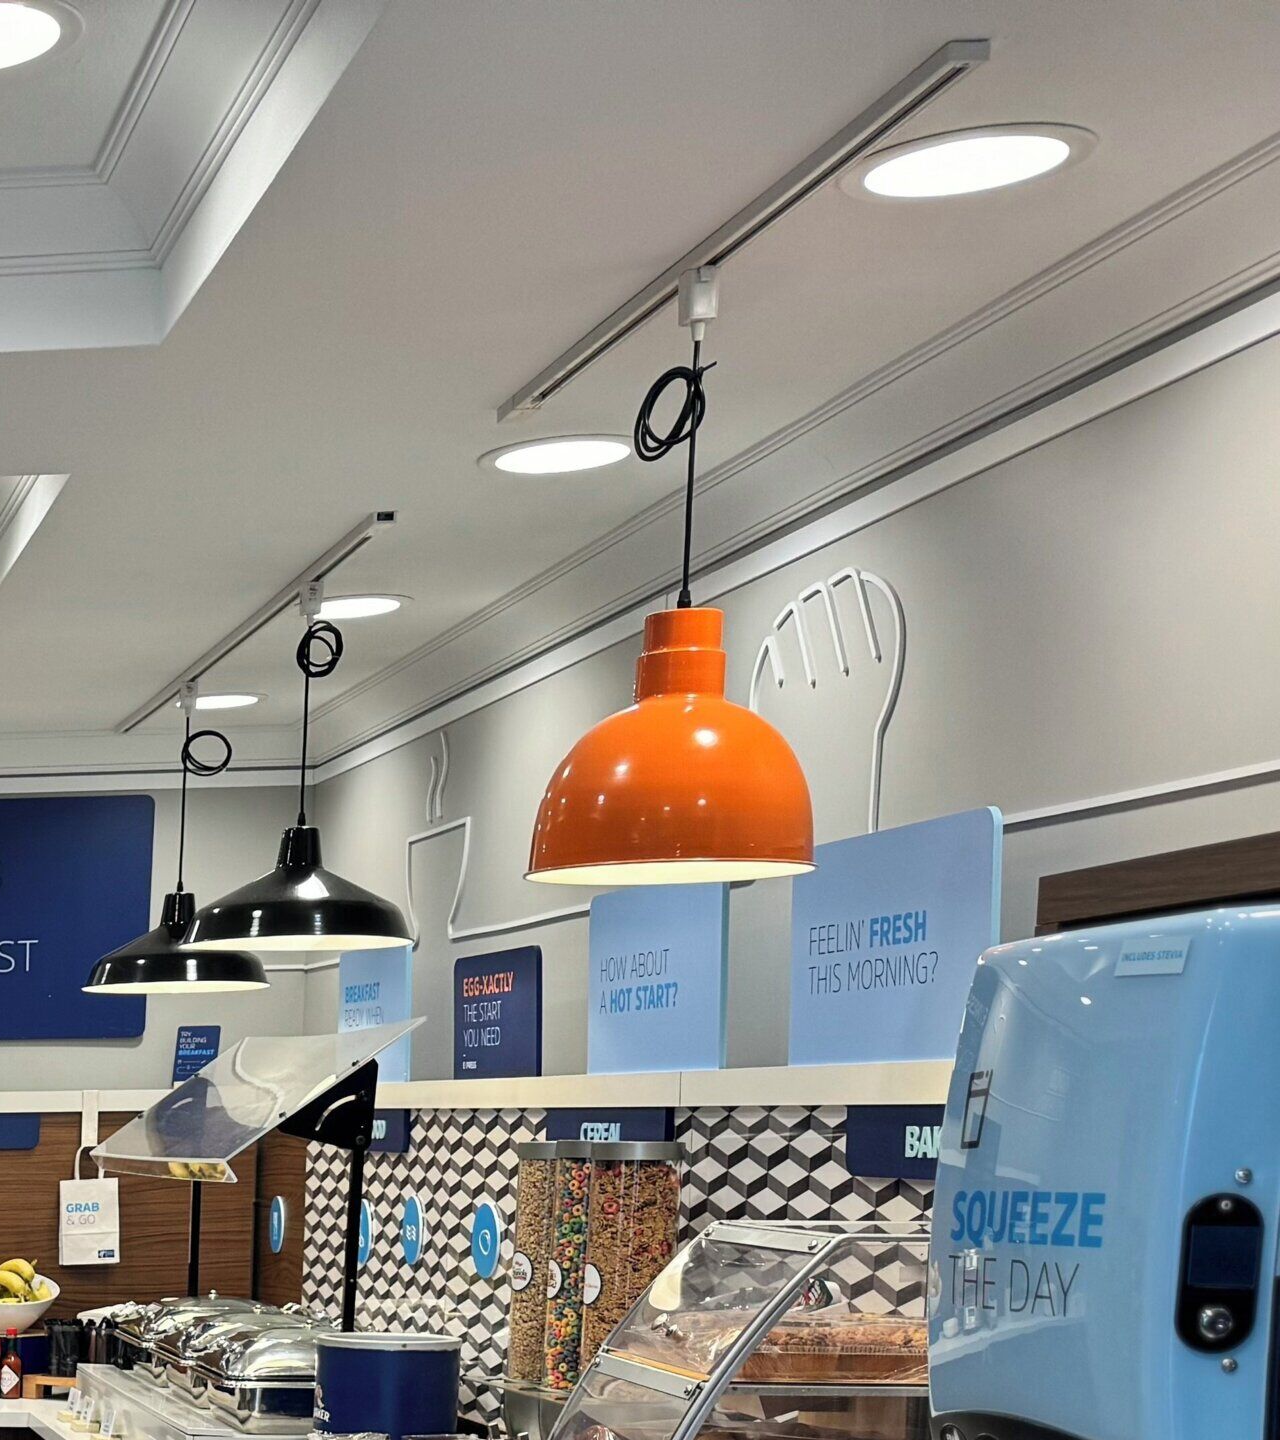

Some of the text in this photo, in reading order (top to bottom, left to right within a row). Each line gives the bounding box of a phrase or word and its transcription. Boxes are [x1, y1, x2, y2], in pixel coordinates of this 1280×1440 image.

[808, 909, 927, 957] FEELIN' FRESH
[600, 948, 670, 983] HOW ABOUT
[808, 950, 939, 996] THIS MORNING?
[344, 982, 380, 1004] BREAKFAST
[462, 971, 514, 998] EGG-XACTLY
[599, 981, 679, 1015] A HOT START?
[463, 1000, 502, 1024] THE START
[463, 1026, 501, 1048] YOU NEED
[904, 1125, 941, 1159] BAK
[65, 1202, 100, 1213] GRAB
[79, 1214, 96, 1225] GO
[950, 1190, 1107, 1248] SQUEEZE
[948, 1254, 1081, 1318] THE DAY
